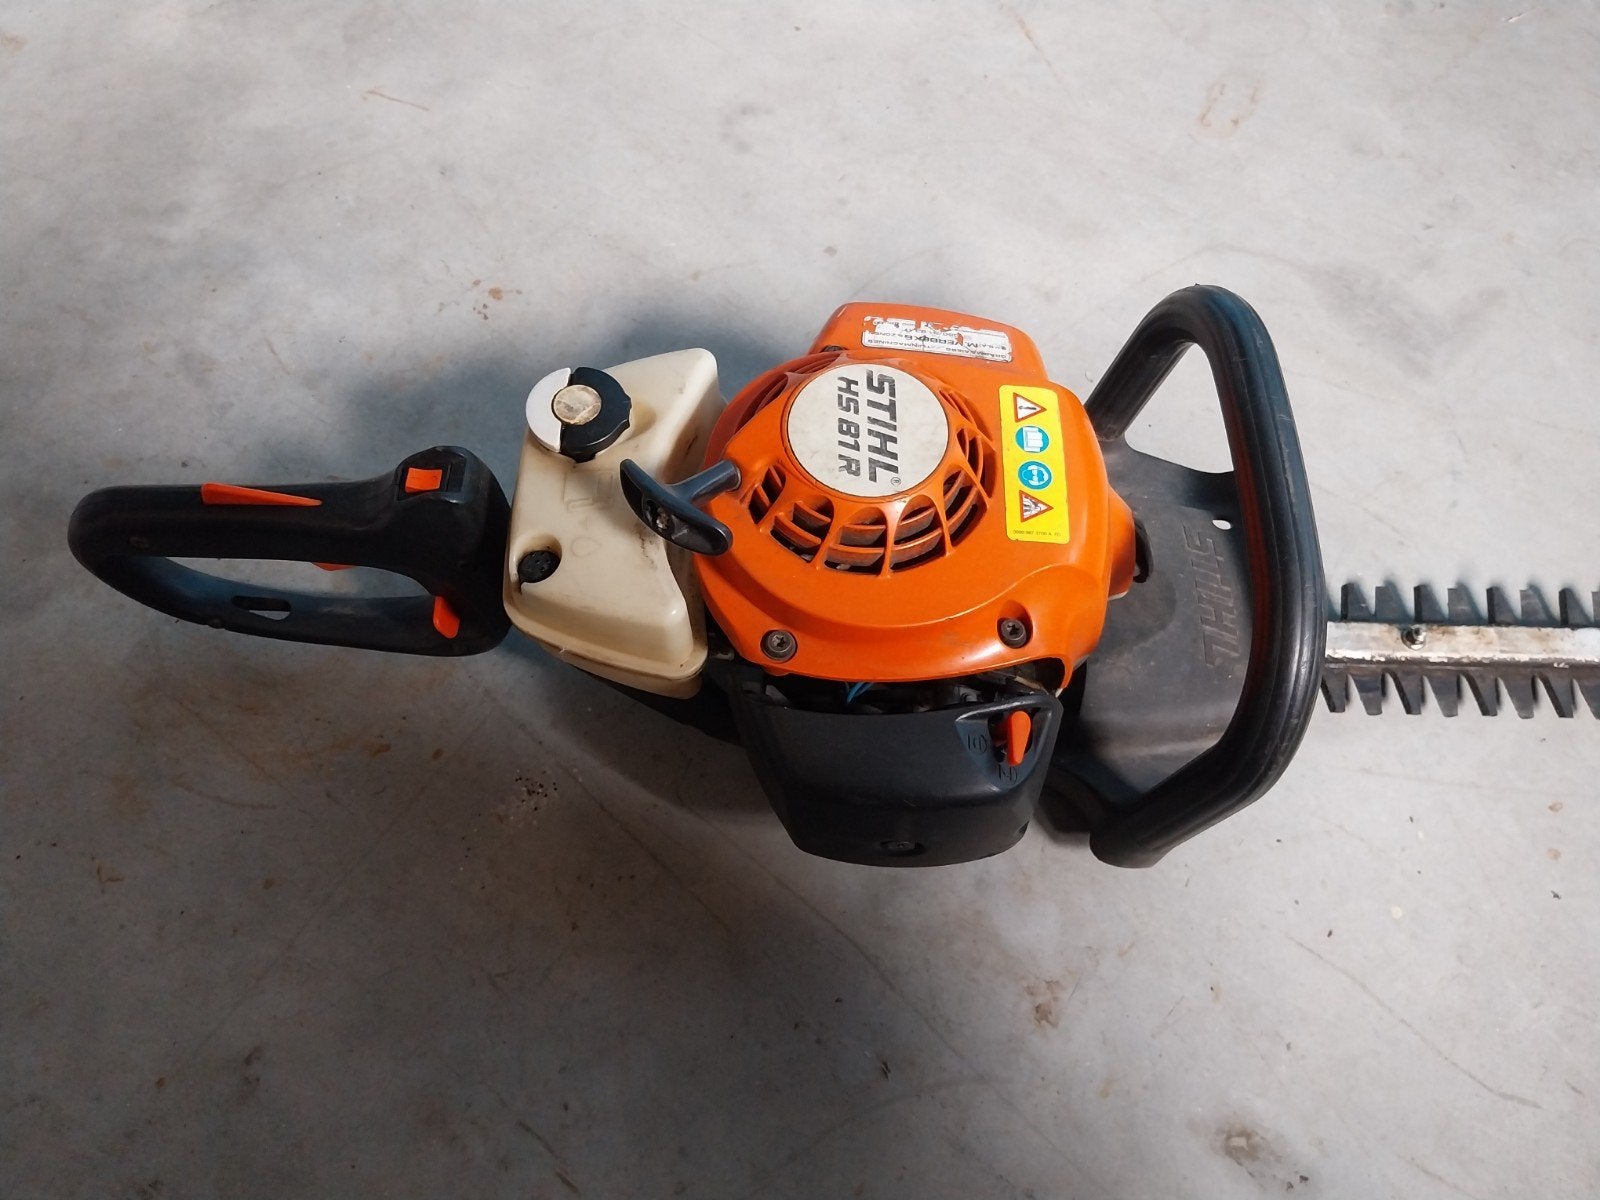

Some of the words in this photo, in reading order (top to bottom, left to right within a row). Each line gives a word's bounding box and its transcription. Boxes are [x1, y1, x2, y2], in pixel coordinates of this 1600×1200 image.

[837, 376, 860, 416] HS
[838, 417, 861, 452] 81
[866, 369, 899, 483] STIHL
[838, 453, 861, 477] R
[1182, 520, 1240, 667] STIHL
